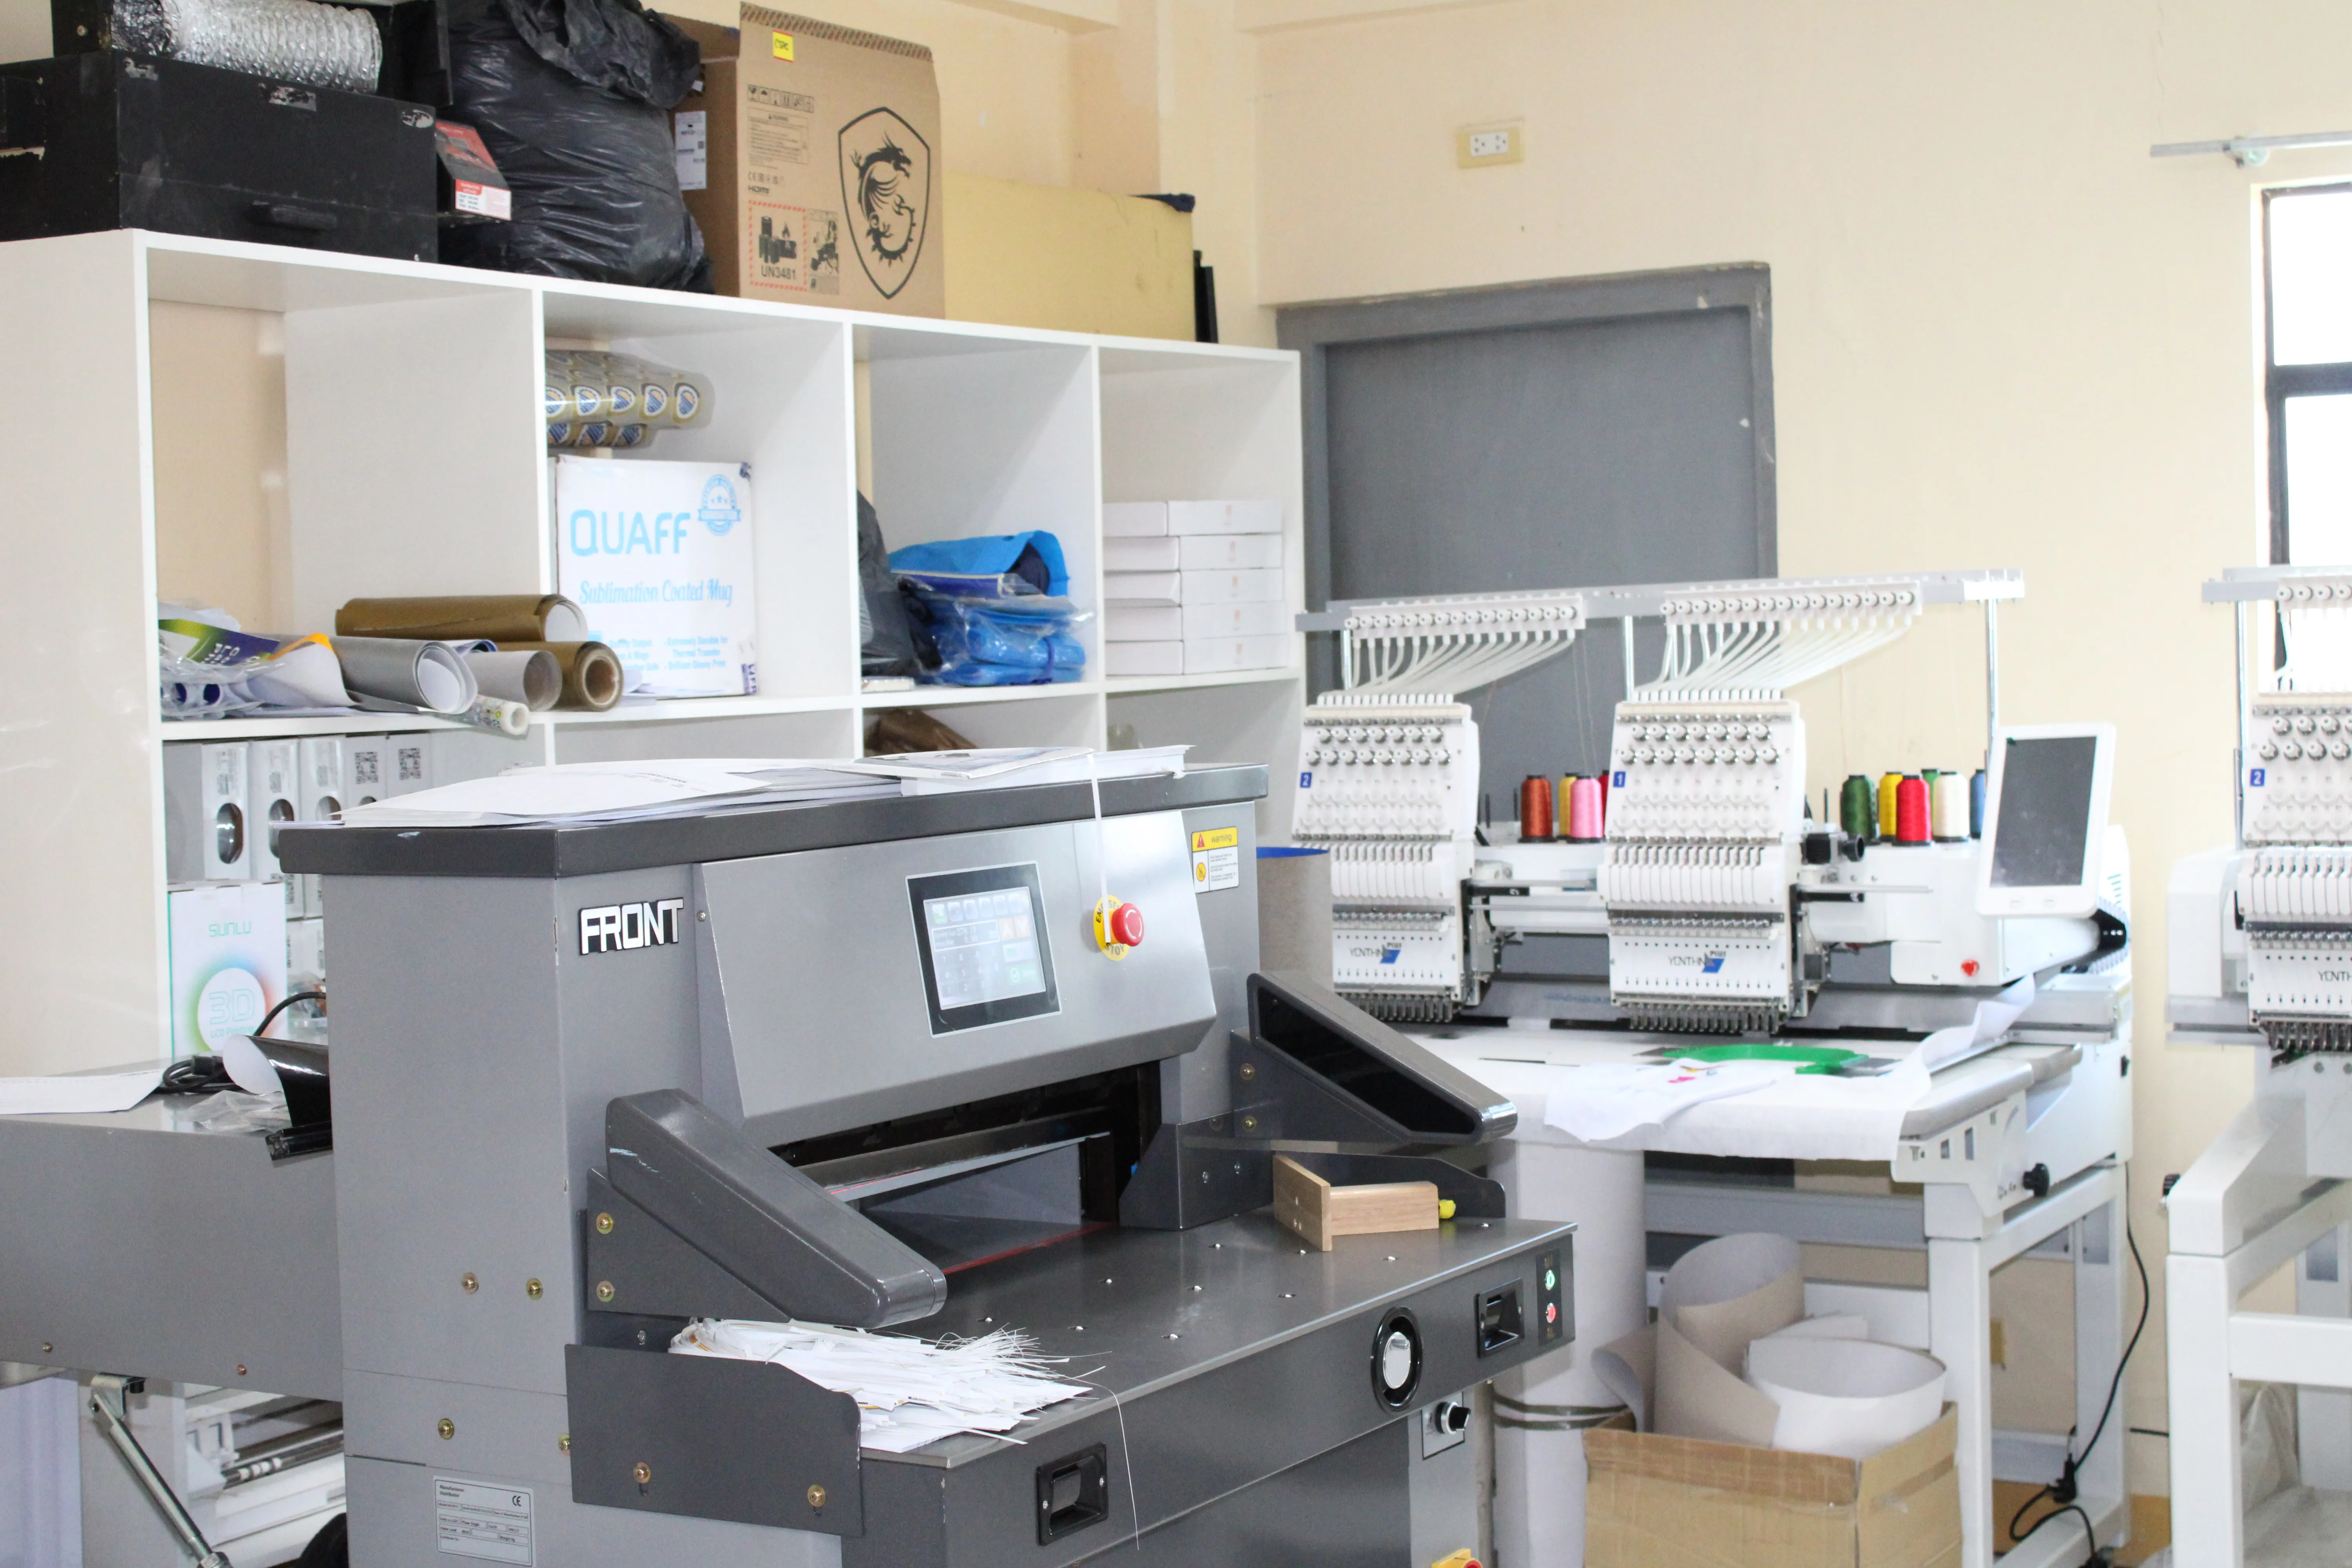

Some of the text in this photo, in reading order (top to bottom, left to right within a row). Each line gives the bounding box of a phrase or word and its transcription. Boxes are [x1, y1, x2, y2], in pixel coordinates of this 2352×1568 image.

[761, 265, 795, 280] UN3481
[570, 510, 690, 557] QUAFF
[579, 578, 733, 607] Sublimation Coated Mug
[1303, 774, 1310, 785] 2
[1617, 774, 1623, 786] 1
[2253, 771, 2262, 784] 2
[1211, 831, 1232, 842] warning
[209, 921, 251, 937] SUNLU
[579, 897, 684, 955] FRONT
[209, 987, 255, 1025] 3D
[512, 1495, 521, 1506] CE
